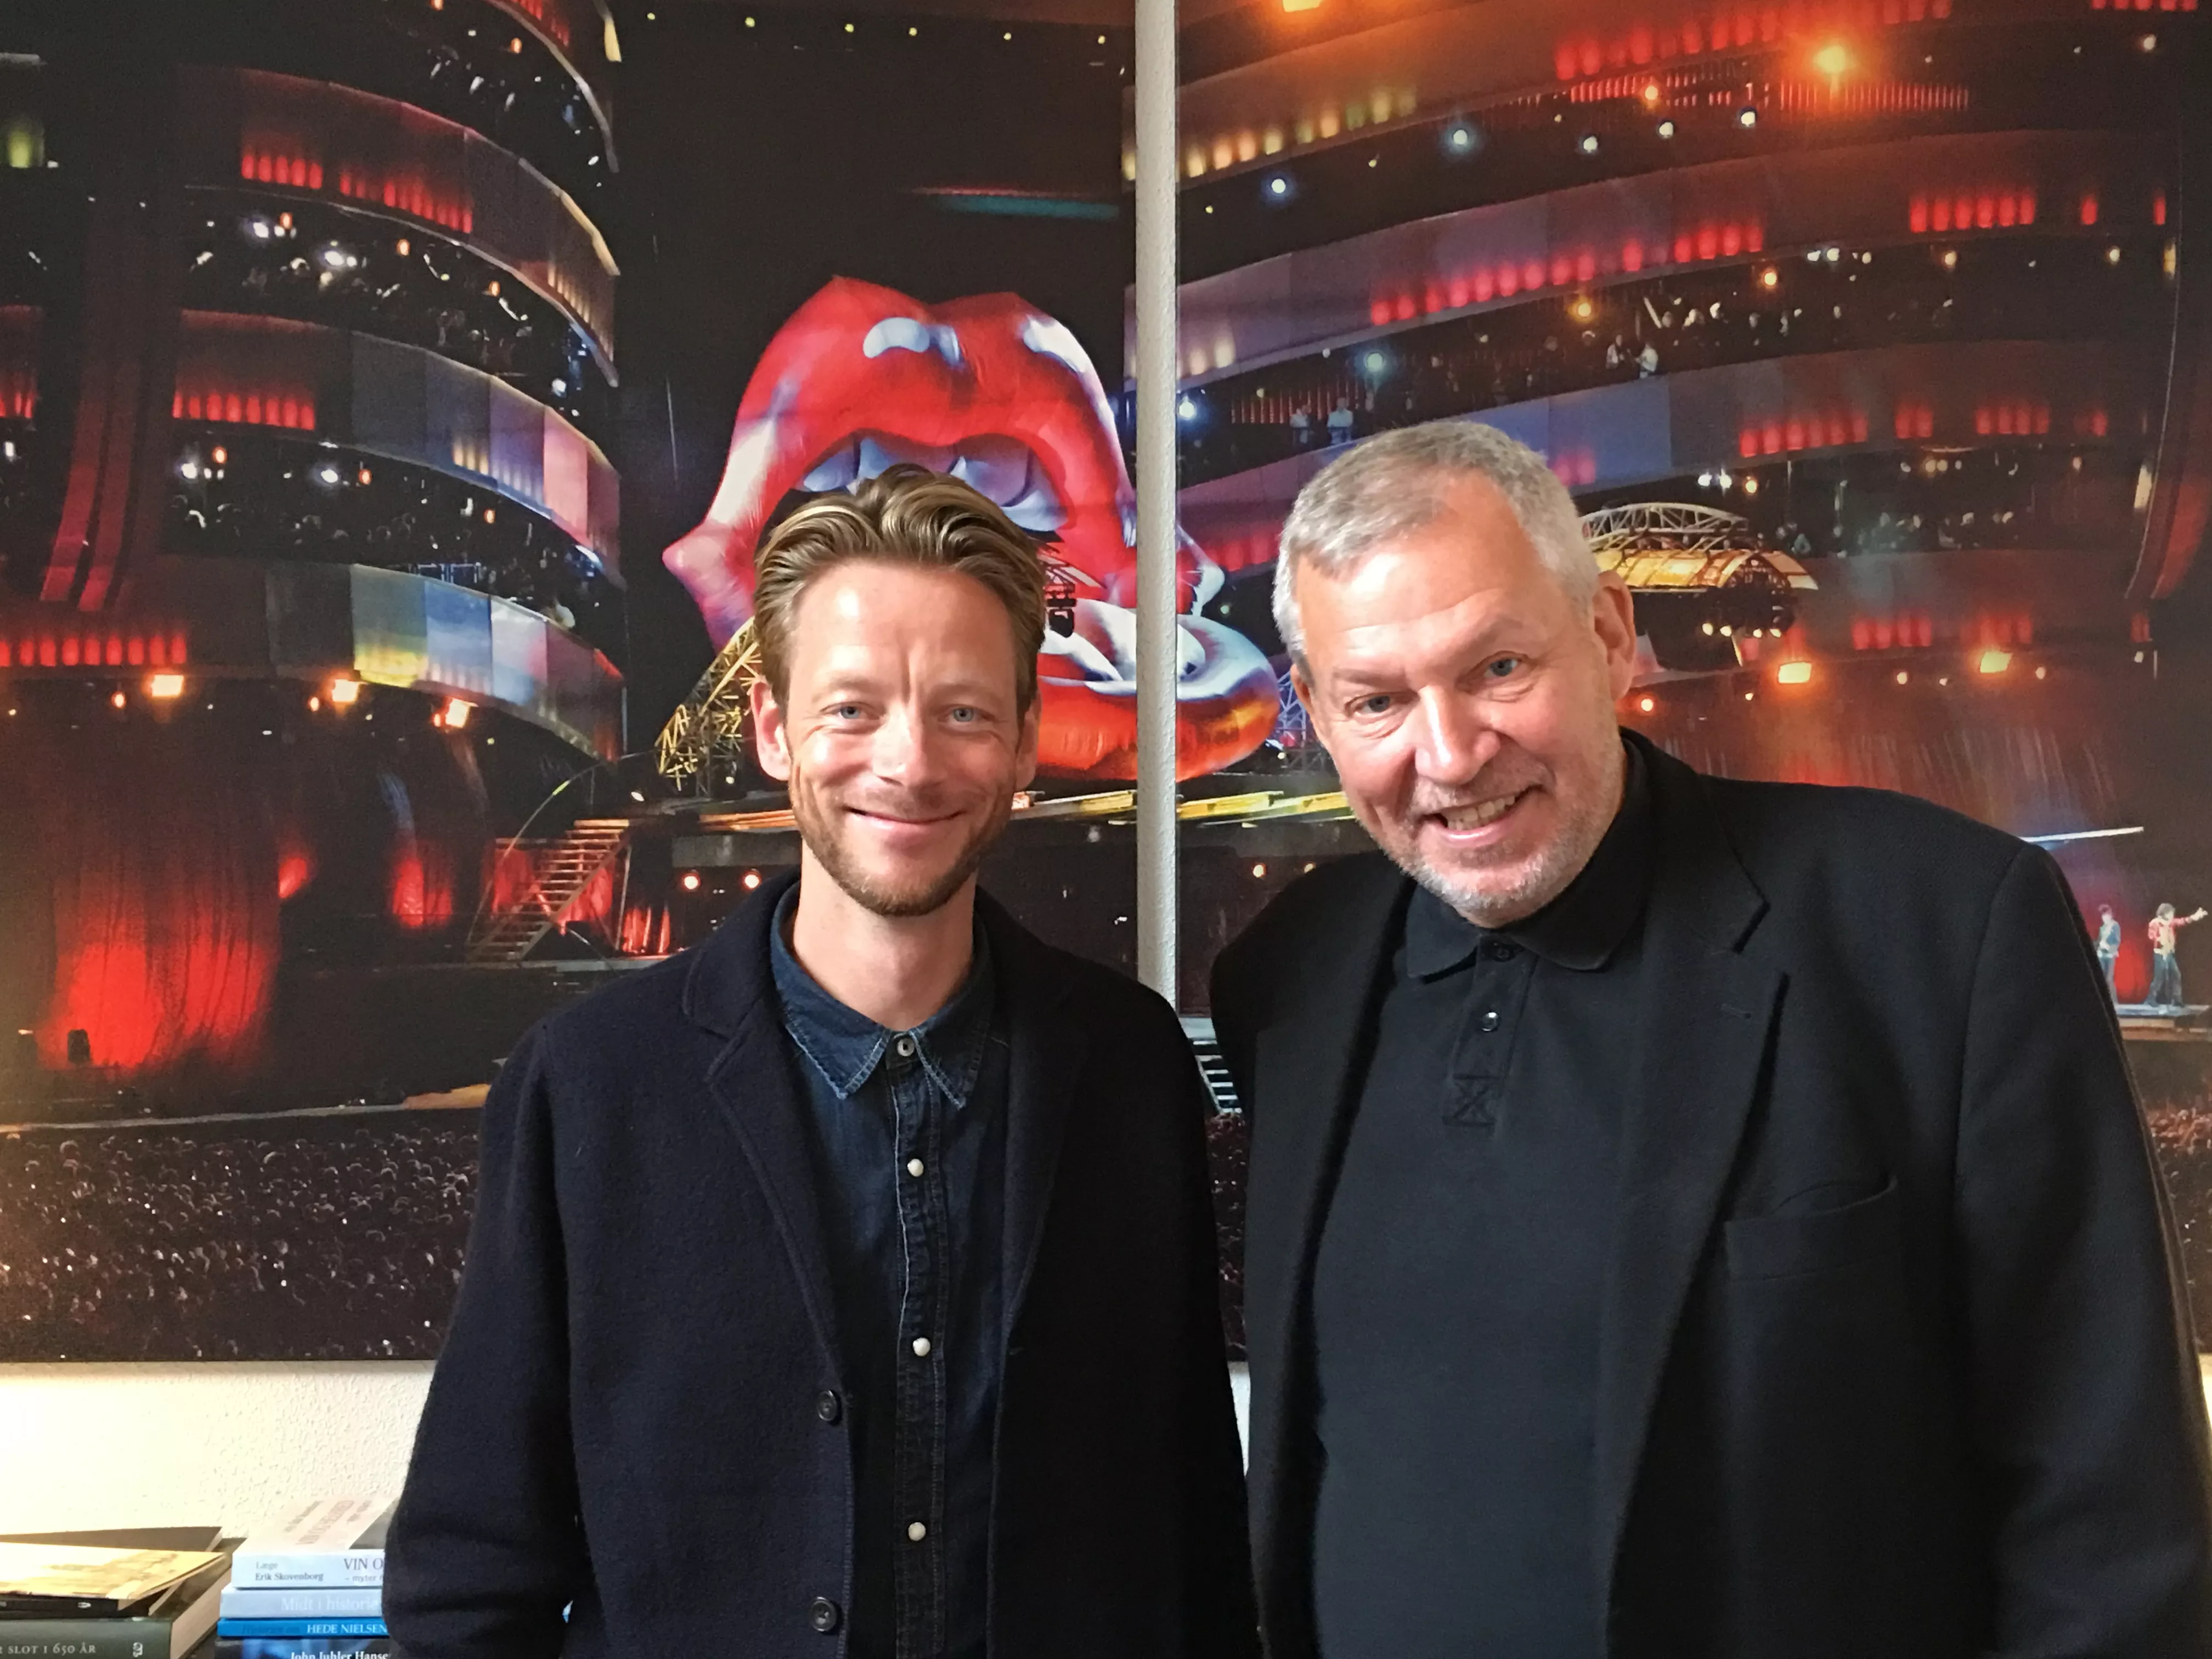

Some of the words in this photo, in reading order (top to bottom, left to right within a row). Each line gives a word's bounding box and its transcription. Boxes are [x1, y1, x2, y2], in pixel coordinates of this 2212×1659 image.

[343, 1558, 368, 1570] VIN
[255, 1572, 272, 1581] Erik
[281, 1596, 313, 1611] Midt
[318, 1597, 322, 1611] i
[307, 1624, 338, 1634] HEDE
[341, 1624, 387, 1634] NIELSEN
[8, 1645, 38, 1655] SLOT
[52, 1643, 75, 1656] 650
[79, 1641, 97, 1654] ÅR
[319, 1651, 352, 1659] Juhler
